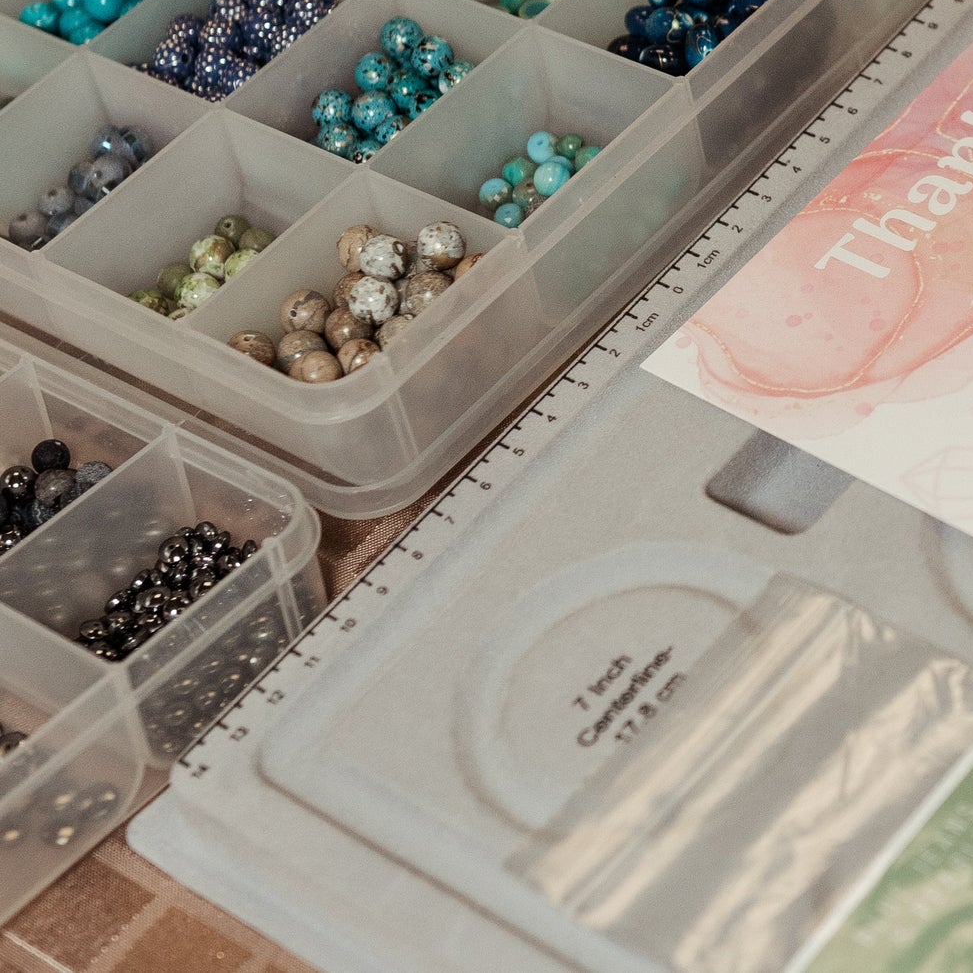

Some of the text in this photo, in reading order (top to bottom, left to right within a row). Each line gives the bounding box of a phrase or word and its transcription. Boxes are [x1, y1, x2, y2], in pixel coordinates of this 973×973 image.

[927, 20, 940, 32] 9
[901, 50, 913, 59] 8
[873, 77, 884, 86] 7
[847, 107, 859, 116] 6
[818, 136, 831, 145] 5
[792, 165, 802, 174] 4
[760, 194, 773, 203] 3
[731, 224, 744, 234] 2
[696, 248, 721, 270] 1cm
[672, 285, 684, 295] 0
[635, 311, 660, 333] 1cm
[608, 348, 621, 358] 2
[577, 381, 590, 390] 3
[546, 414, 557, 423] 4
[512, 447, 525, 457] 5
[479, 481, 492, 491] 6
[444, 515, 455, 525] 7
[411, 550, 424, 561] 8
[376, 586, 389, 596] 9
[339, 617, 357, 633] 10
[572, 654, 632, 711] 7 Inch
[655, 672, 688, 702] cm
